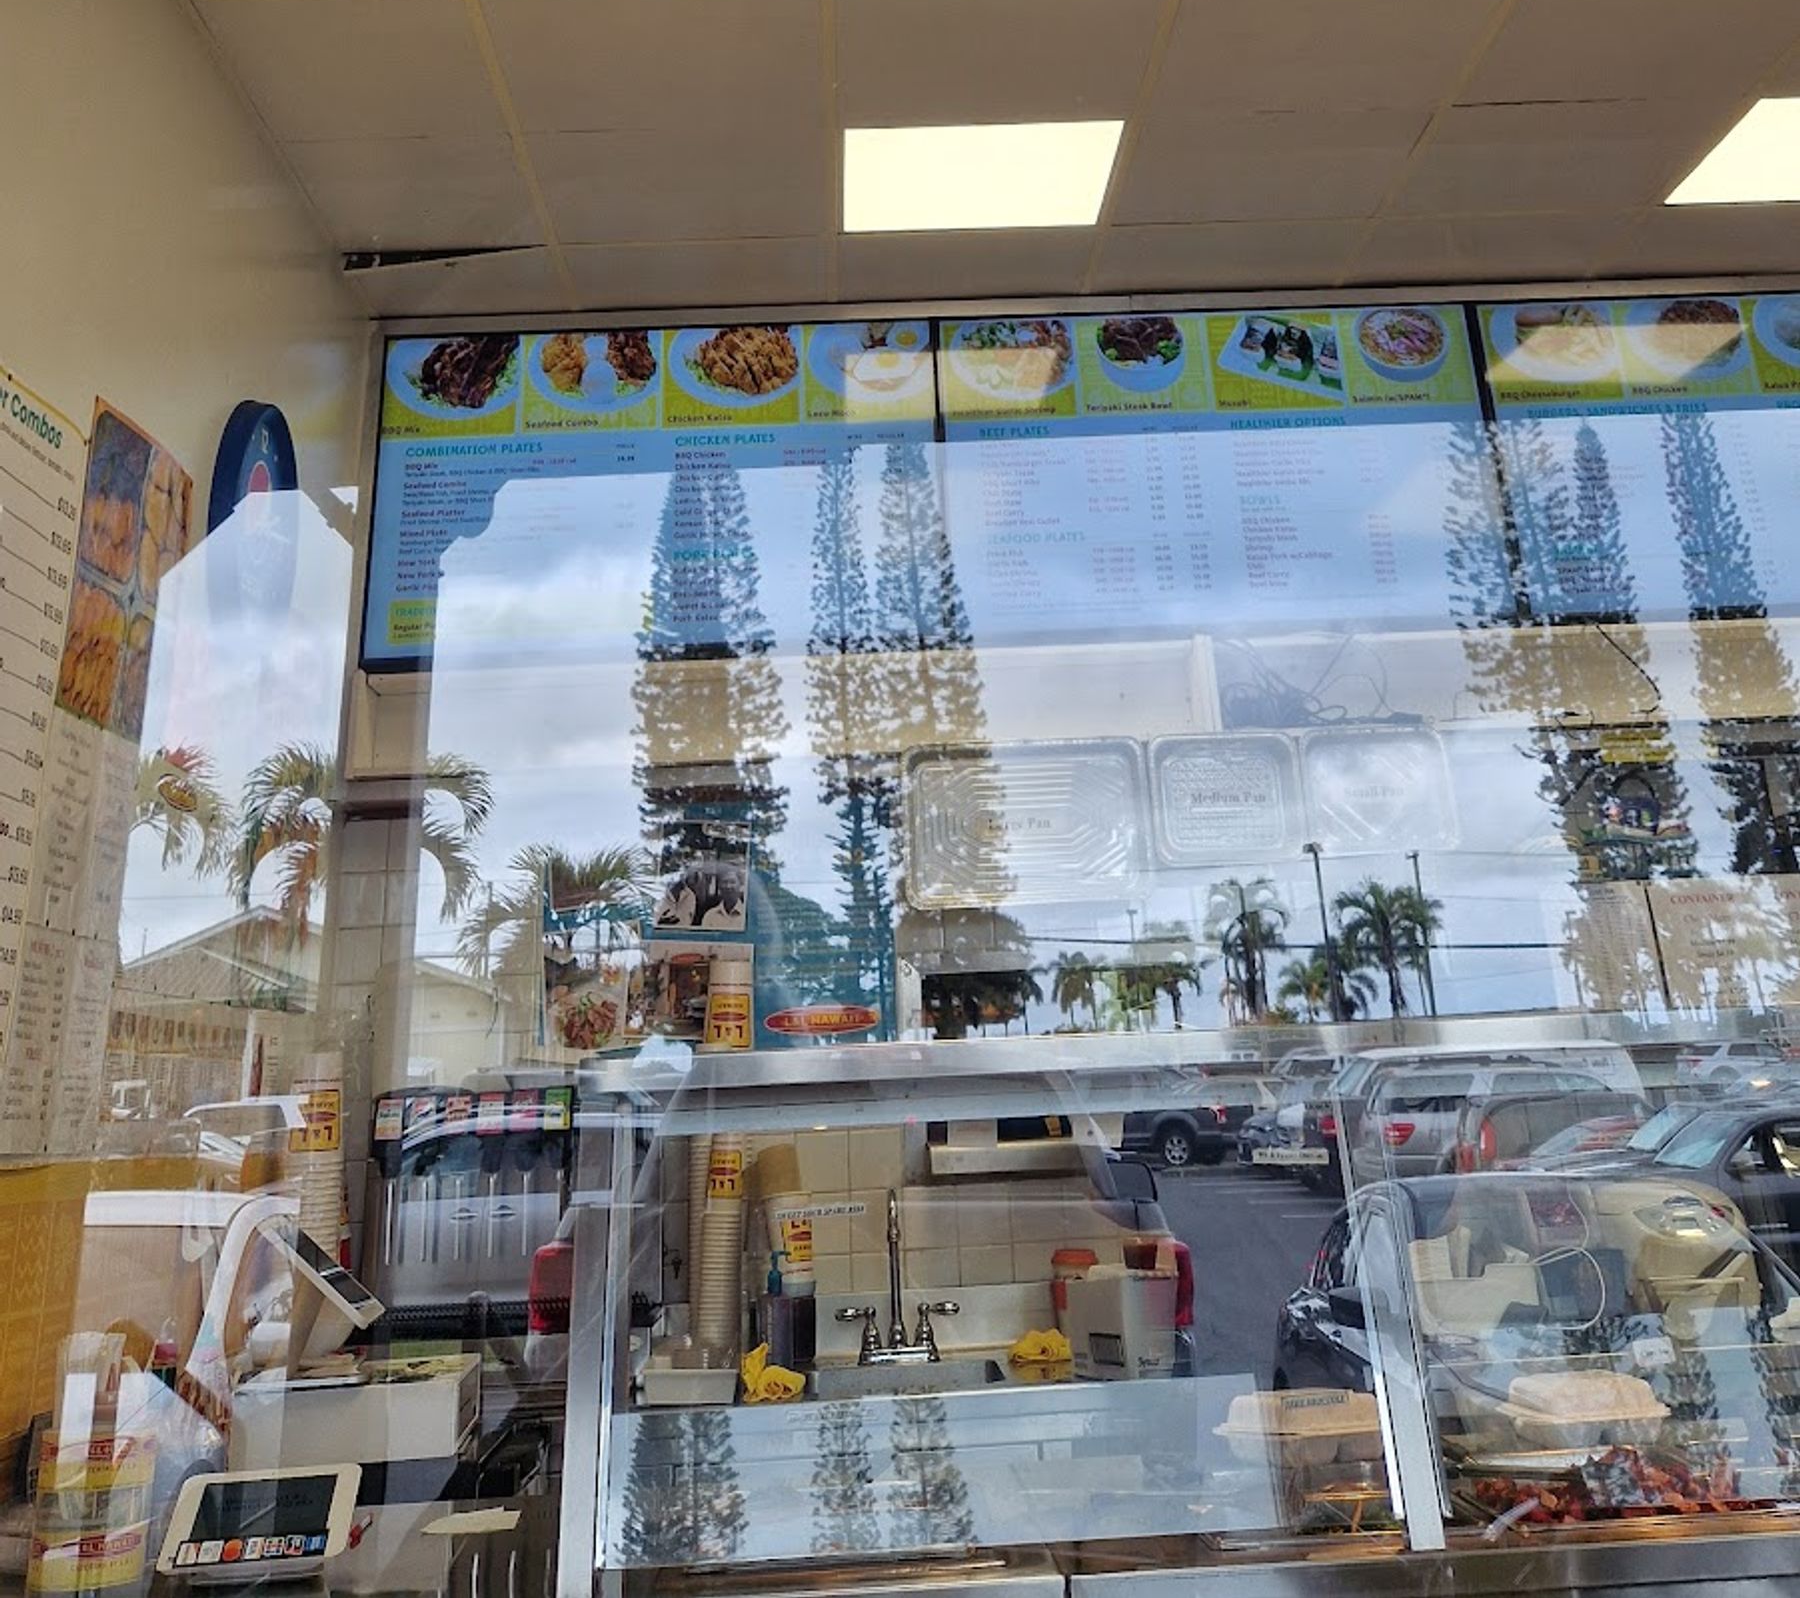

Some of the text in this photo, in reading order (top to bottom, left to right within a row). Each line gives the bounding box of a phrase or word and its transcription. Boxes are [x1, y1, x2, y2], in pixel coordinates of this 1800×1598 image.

[10, 394, 63, 449] Combos
[525, 420, 563, 429] Seafood
[1294, 416, 1346, 427] OPTIONS
[979, 426, 1050, 438] BEEF PLATES
[675, 434, 775, 447] CHICKEN PLATES
[405, 442, 543, 458] COMBINATION PLATES
[1045, 530, 1086, 542] PLATES
[1190, 792, 1266, 803] Medium Pan
[1027, 817, 1051, 828] Pan
